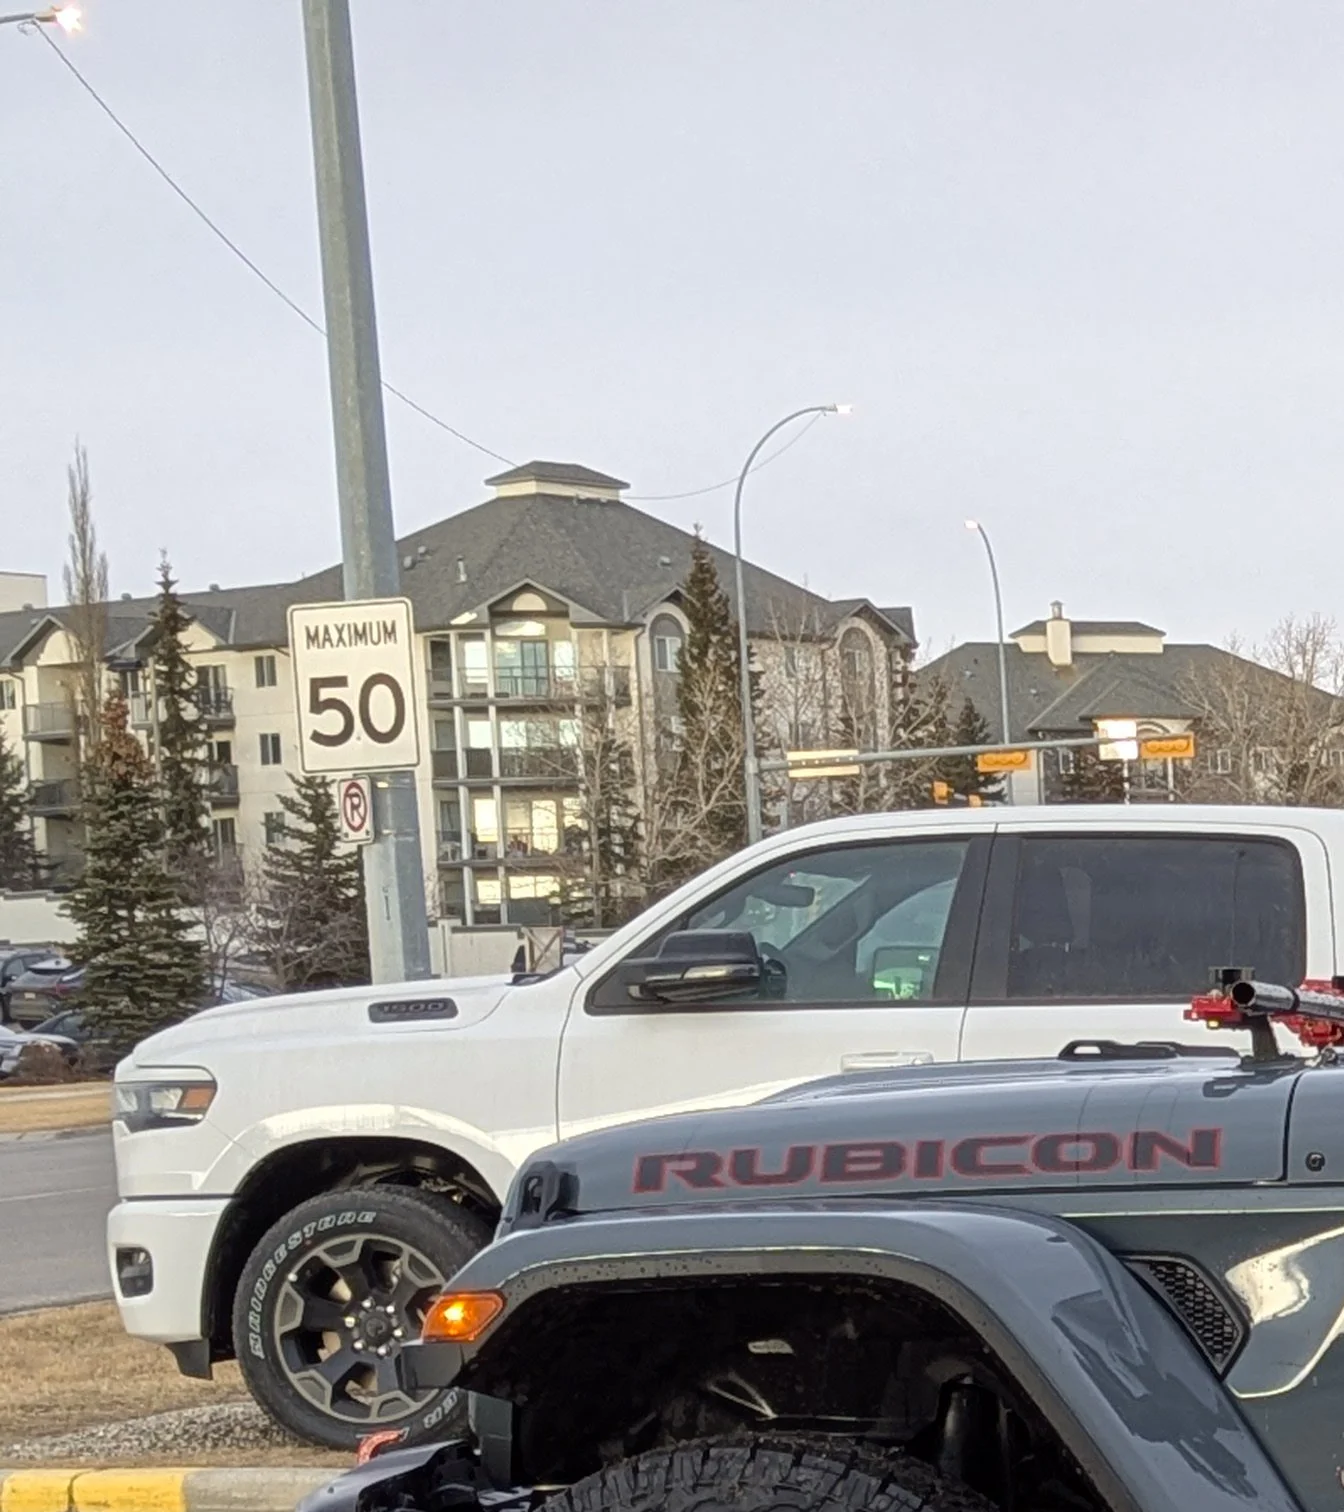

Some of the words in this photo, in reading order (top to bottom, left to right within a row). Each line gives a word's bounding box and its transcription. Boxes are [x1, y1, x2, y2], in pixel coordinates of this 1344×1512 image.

[304, 619, 398, 650] MAXIMUM
[309, 672, 406, 748] 50
[632, 1127, 1223, 1194] RUBICON
